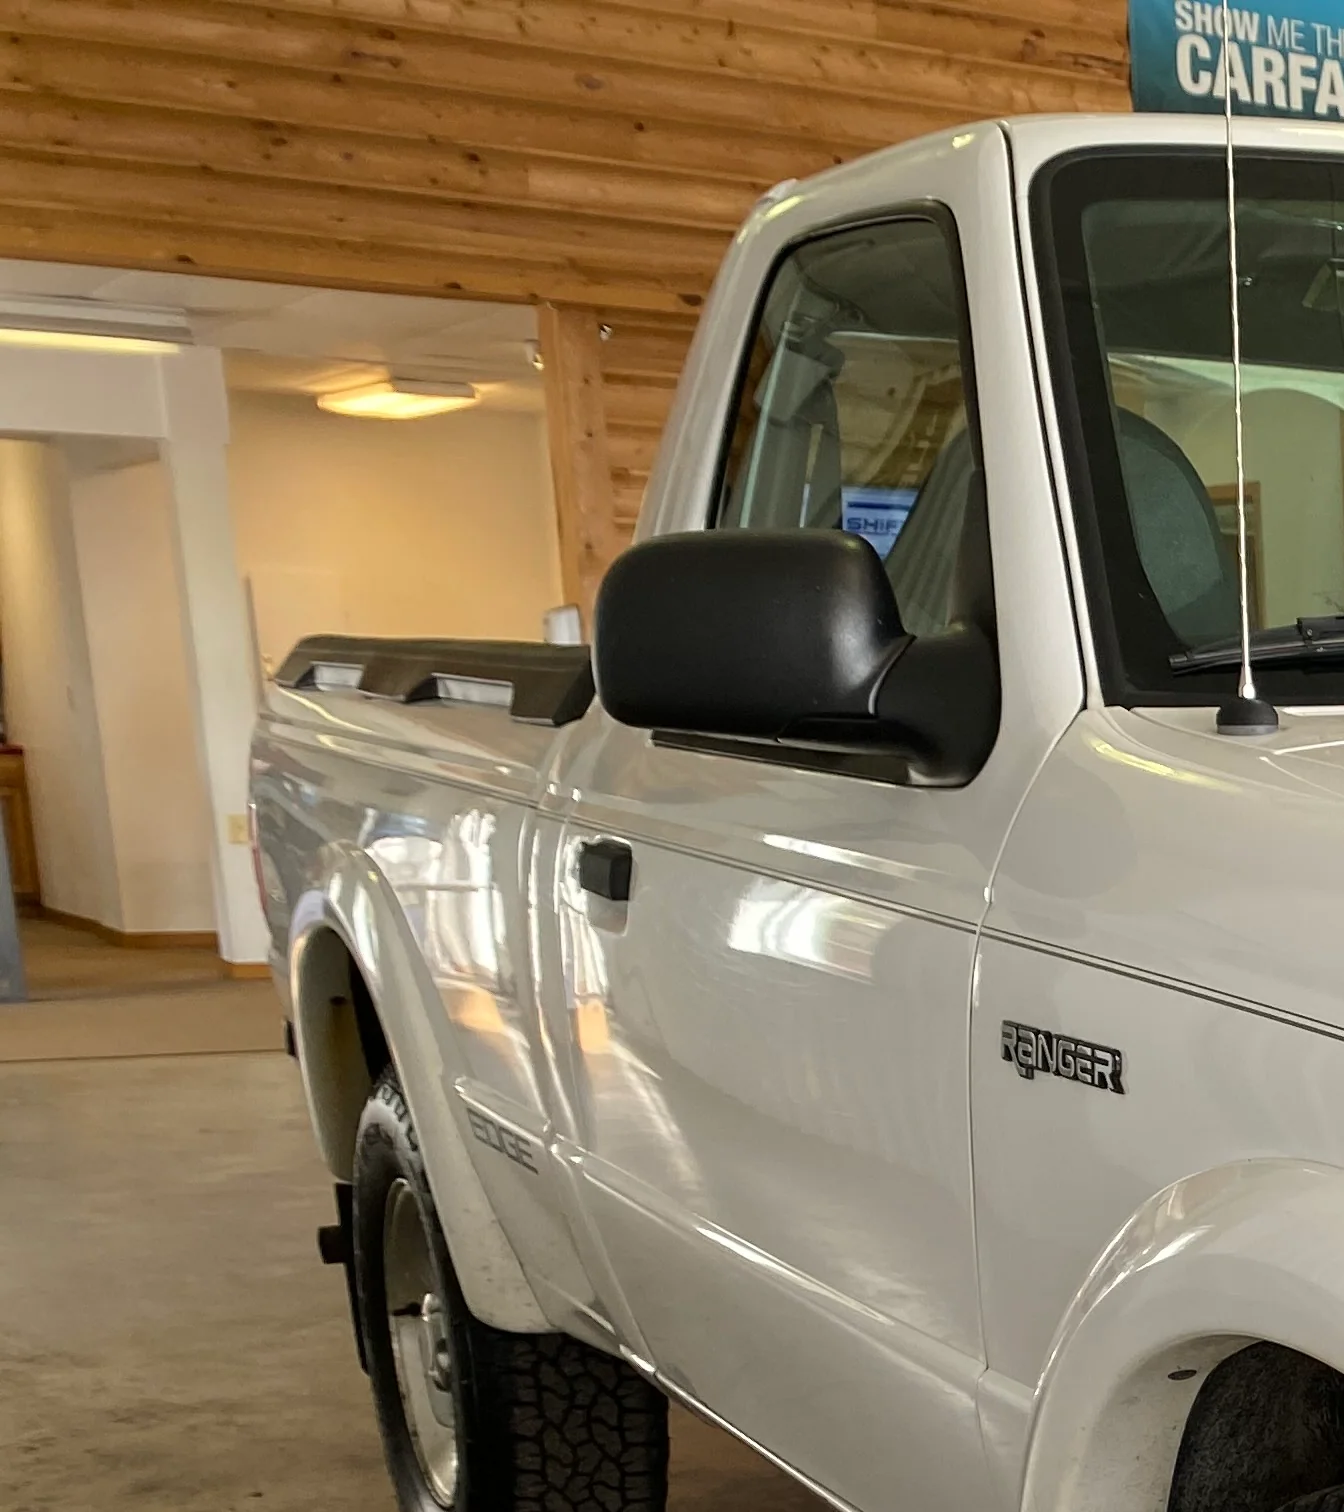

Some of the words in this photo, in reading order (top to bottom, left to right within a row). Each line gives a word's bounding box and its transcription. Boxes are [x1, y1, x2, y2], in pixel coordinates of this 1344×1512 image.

[1174, 0, 1260, 43] SHOW
[1266, 15, 1307, 53] ME
[466, 1107, 539, 1176] EDGE
